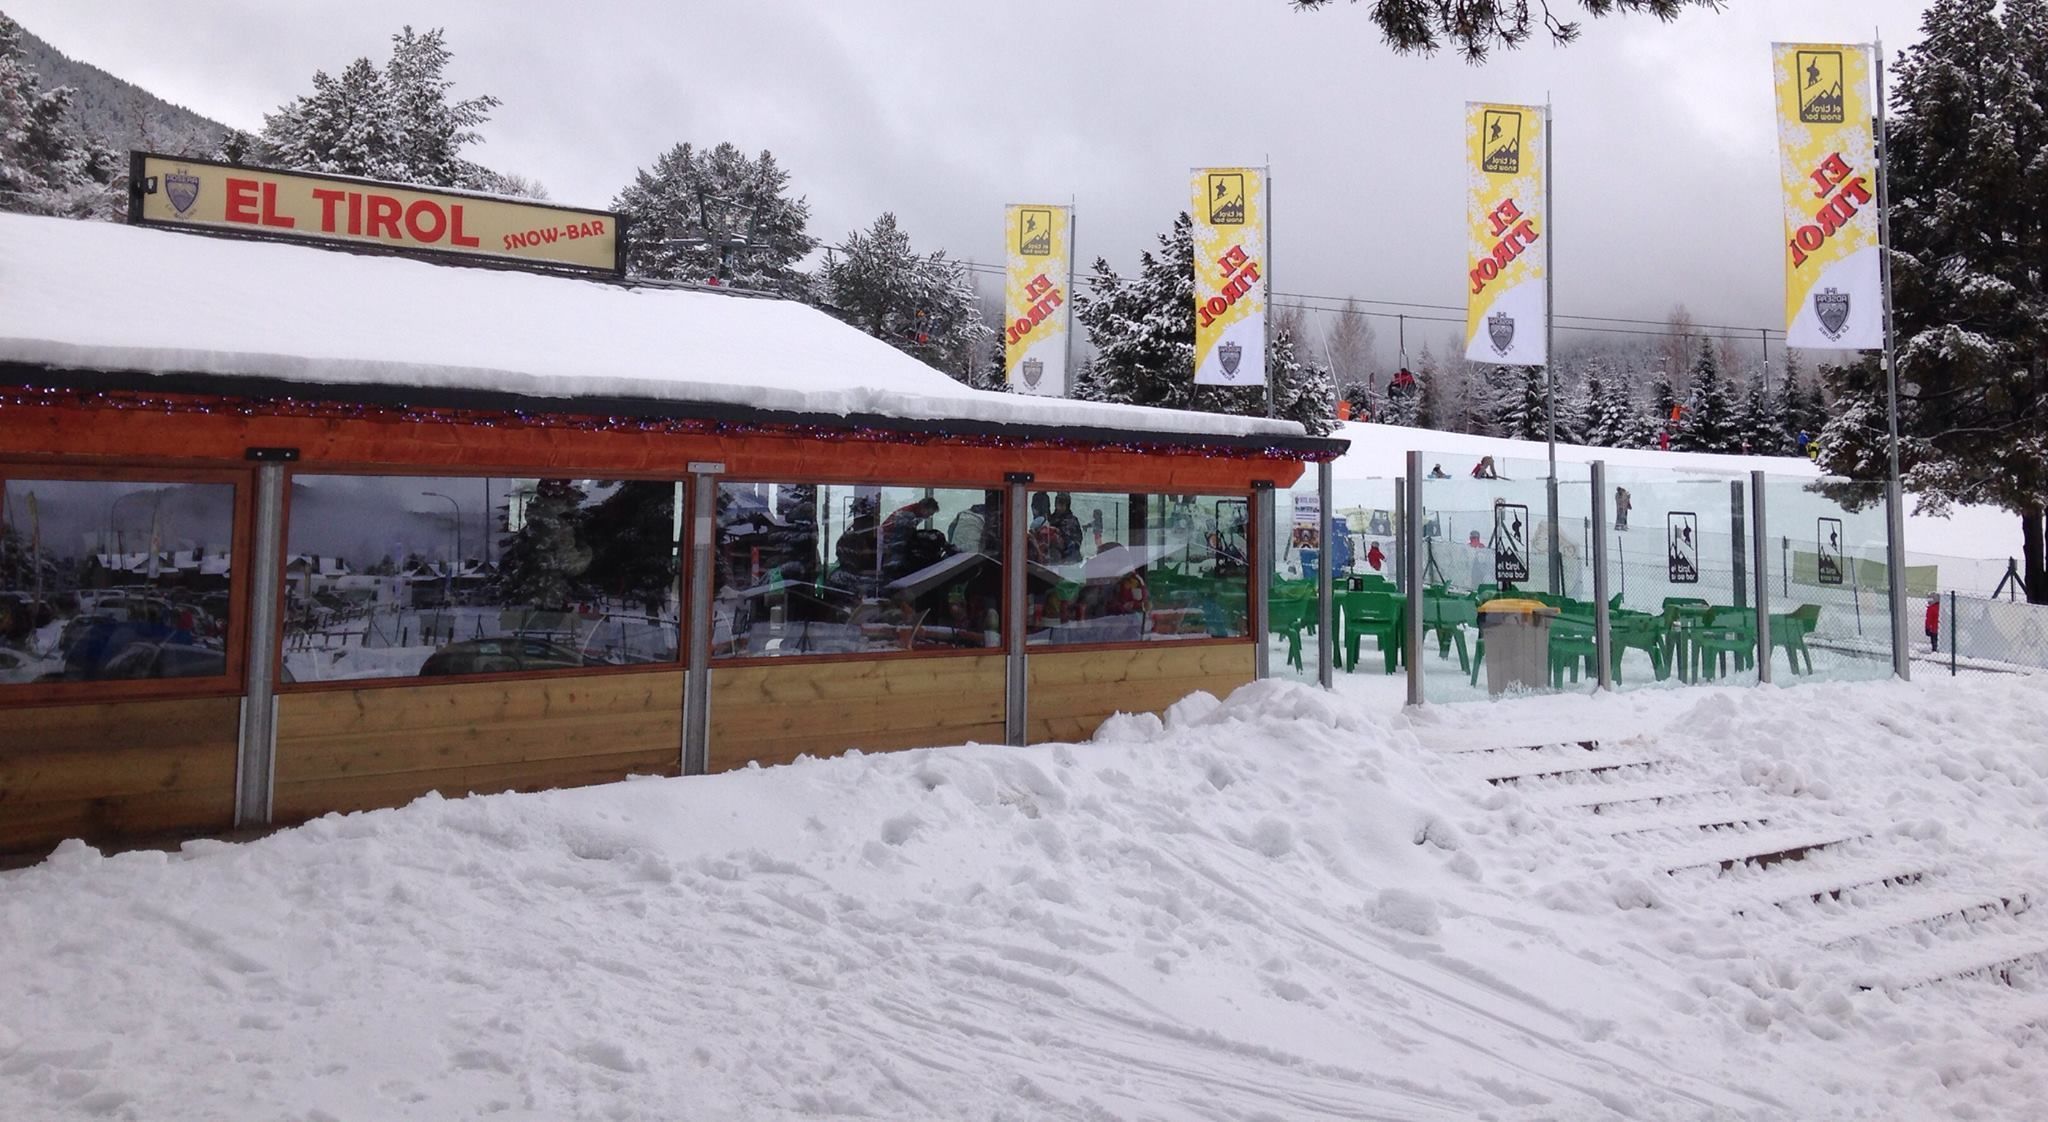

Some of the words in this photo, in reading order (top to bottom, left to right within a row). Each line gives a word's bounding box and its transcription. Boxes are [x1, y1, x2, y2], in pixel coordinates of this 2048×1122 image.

[225, 178, 295, 228] EL
[312, 188, 480, 248] TIROL
[503, 220, 605, 250] SNOW-BAR
[1497, 562, 1504, 570] el
[1505, 562, 1520, 571] tirol
